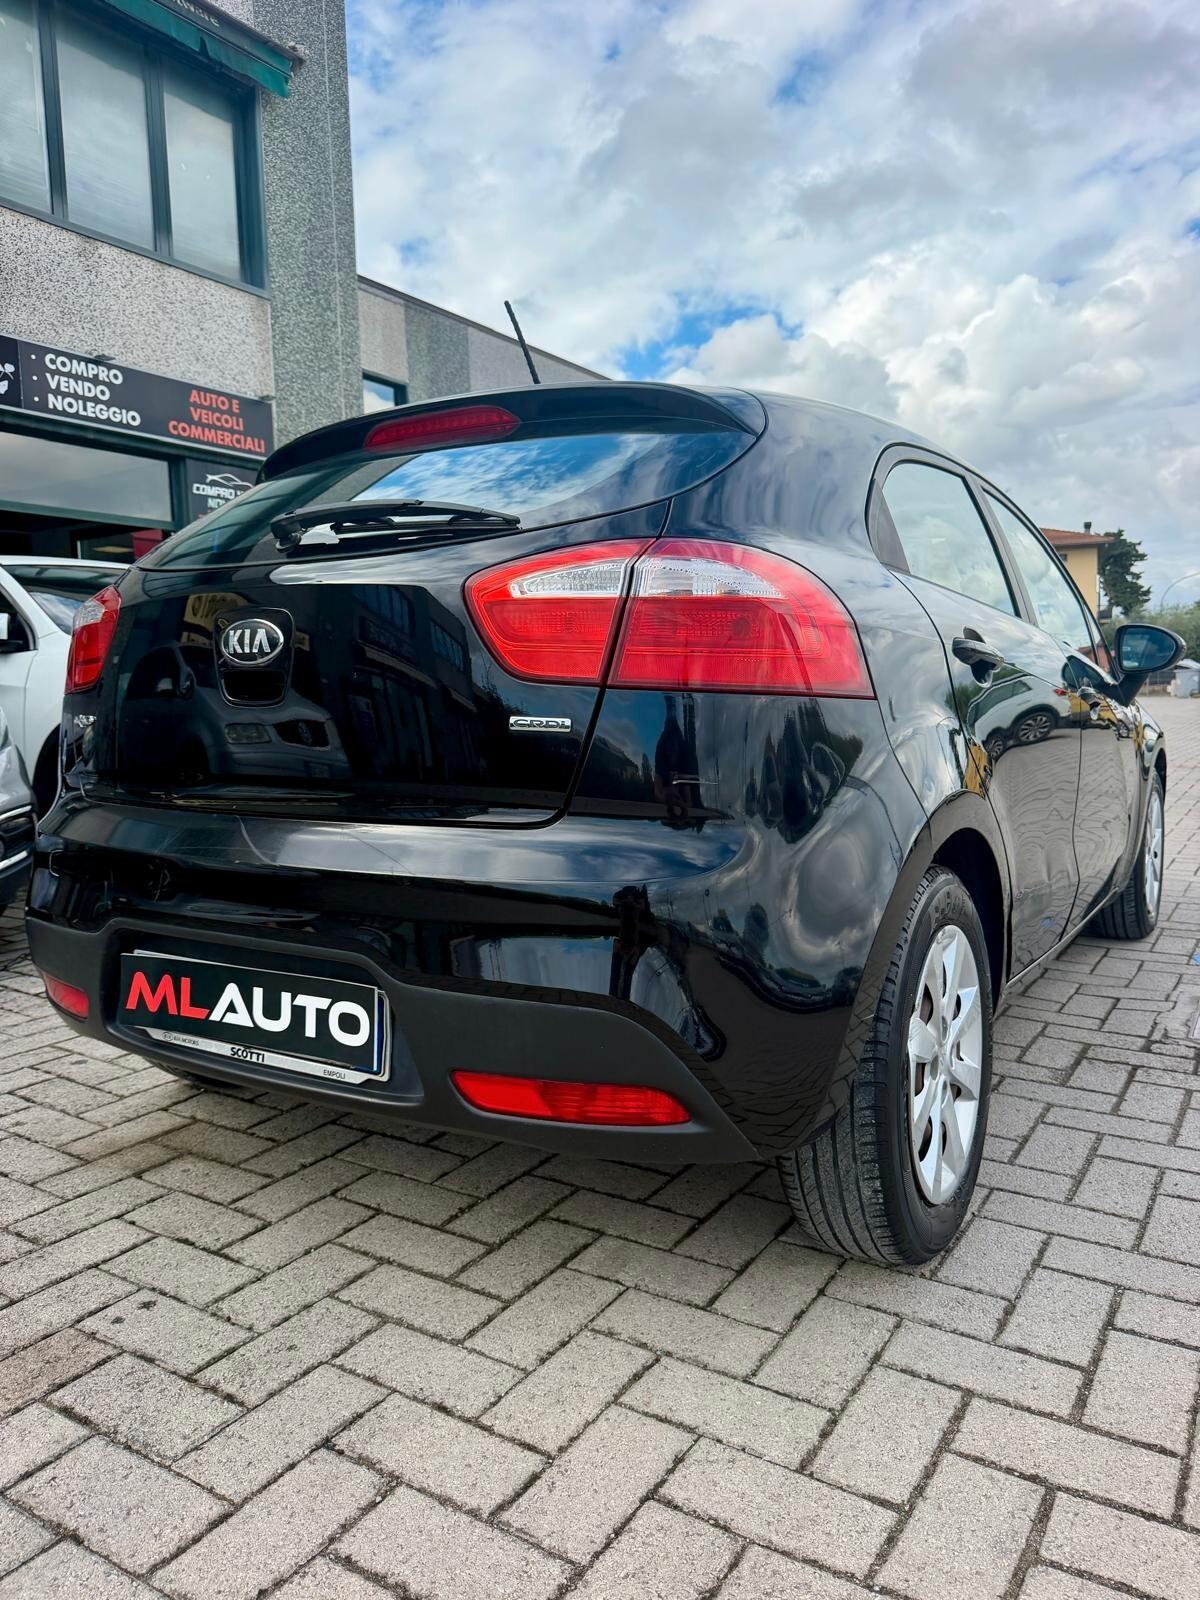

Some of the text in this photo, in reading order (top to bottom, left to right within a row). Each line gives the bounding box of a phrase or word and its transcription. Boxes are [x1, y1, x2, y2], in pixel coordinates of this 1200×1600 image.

[44, 353, 123, 385] COMPRO
[45, 372, 110, 400] VENDO
[47, 393, 141, 427] NOLEGGIO
[189, 389, 240, 413] AUTO E
[190, 406, 244, 431] VEICOLI
[168, 420, 265, 453] COMMERCIALI
[192, 483, 236, 500] COMPRO
[228, 628, 271, 654] KIA
[230, 1047, 265, 1063] SCOTTI
[323, 1069, 346, 1080] EMPOLI
